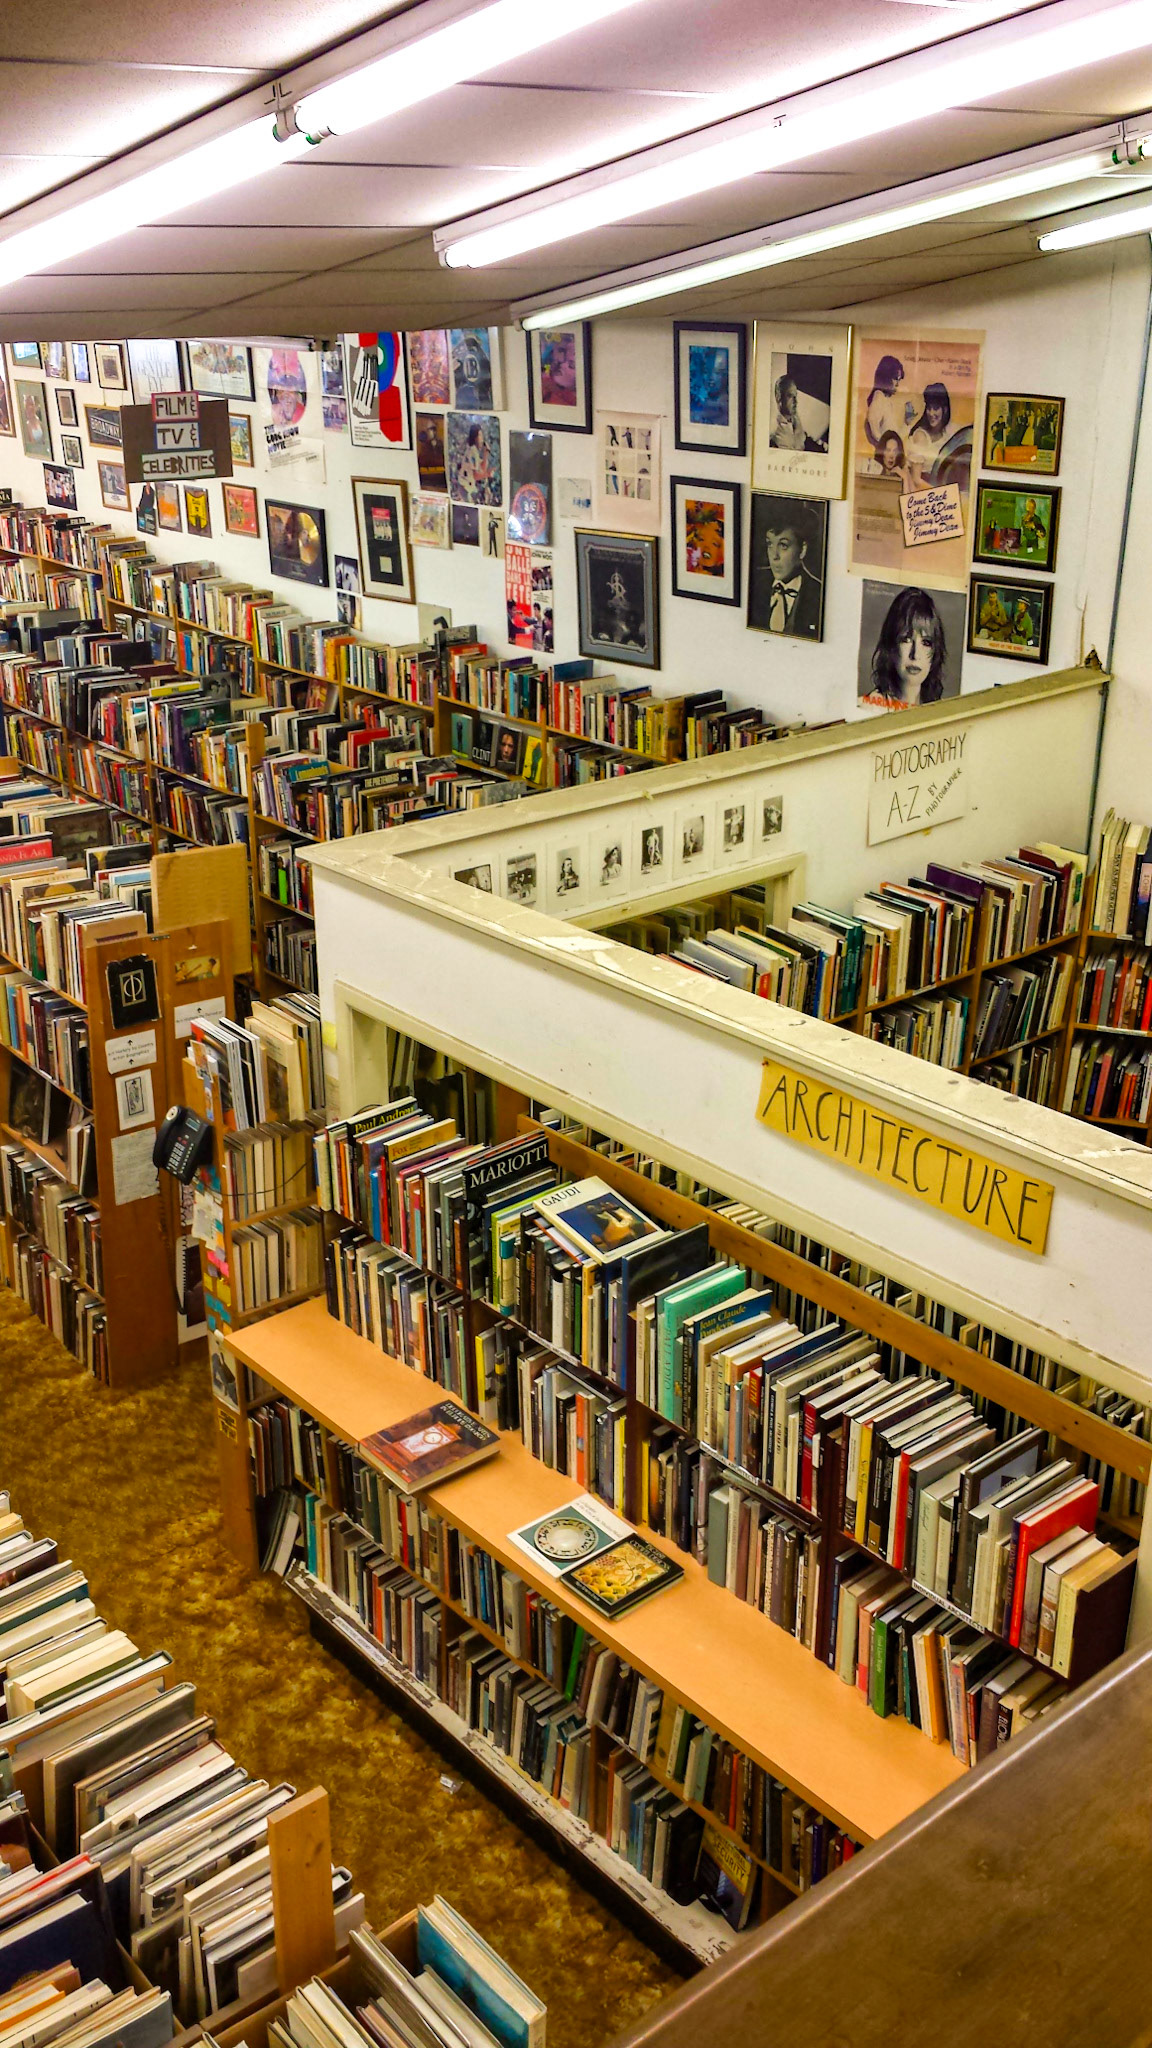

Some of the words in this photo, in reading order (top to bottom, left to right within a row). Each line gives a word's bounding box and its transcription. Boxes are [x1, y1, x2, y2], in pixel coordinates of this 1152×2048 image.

[156, 396, 188, 417] FILM
[157, 428, 184, 445] TV
[927, 490, 947, 503] Back
[874, 732, 966, 782] PHOTOGRAPHY
[925, 767, 962, 817] PHOTOGRAPHER
[927, 782, 938, 797] BY
[354, 1117, 377, 1135] Paul
[469, 1143, 549, 1189] MARIOTTI
[762, 1074, 1040, 1245] ARCHITECTURE
[541, 1186, 581, 1207] GAUDI
[717, 1305, 746, 1322] Claude
[750, 1377, 758, 1404] WITH
[913, 1581, 946, 1608] INDIVIDUAL
[946, 1604, 984, 1632] ARCHITECTS
